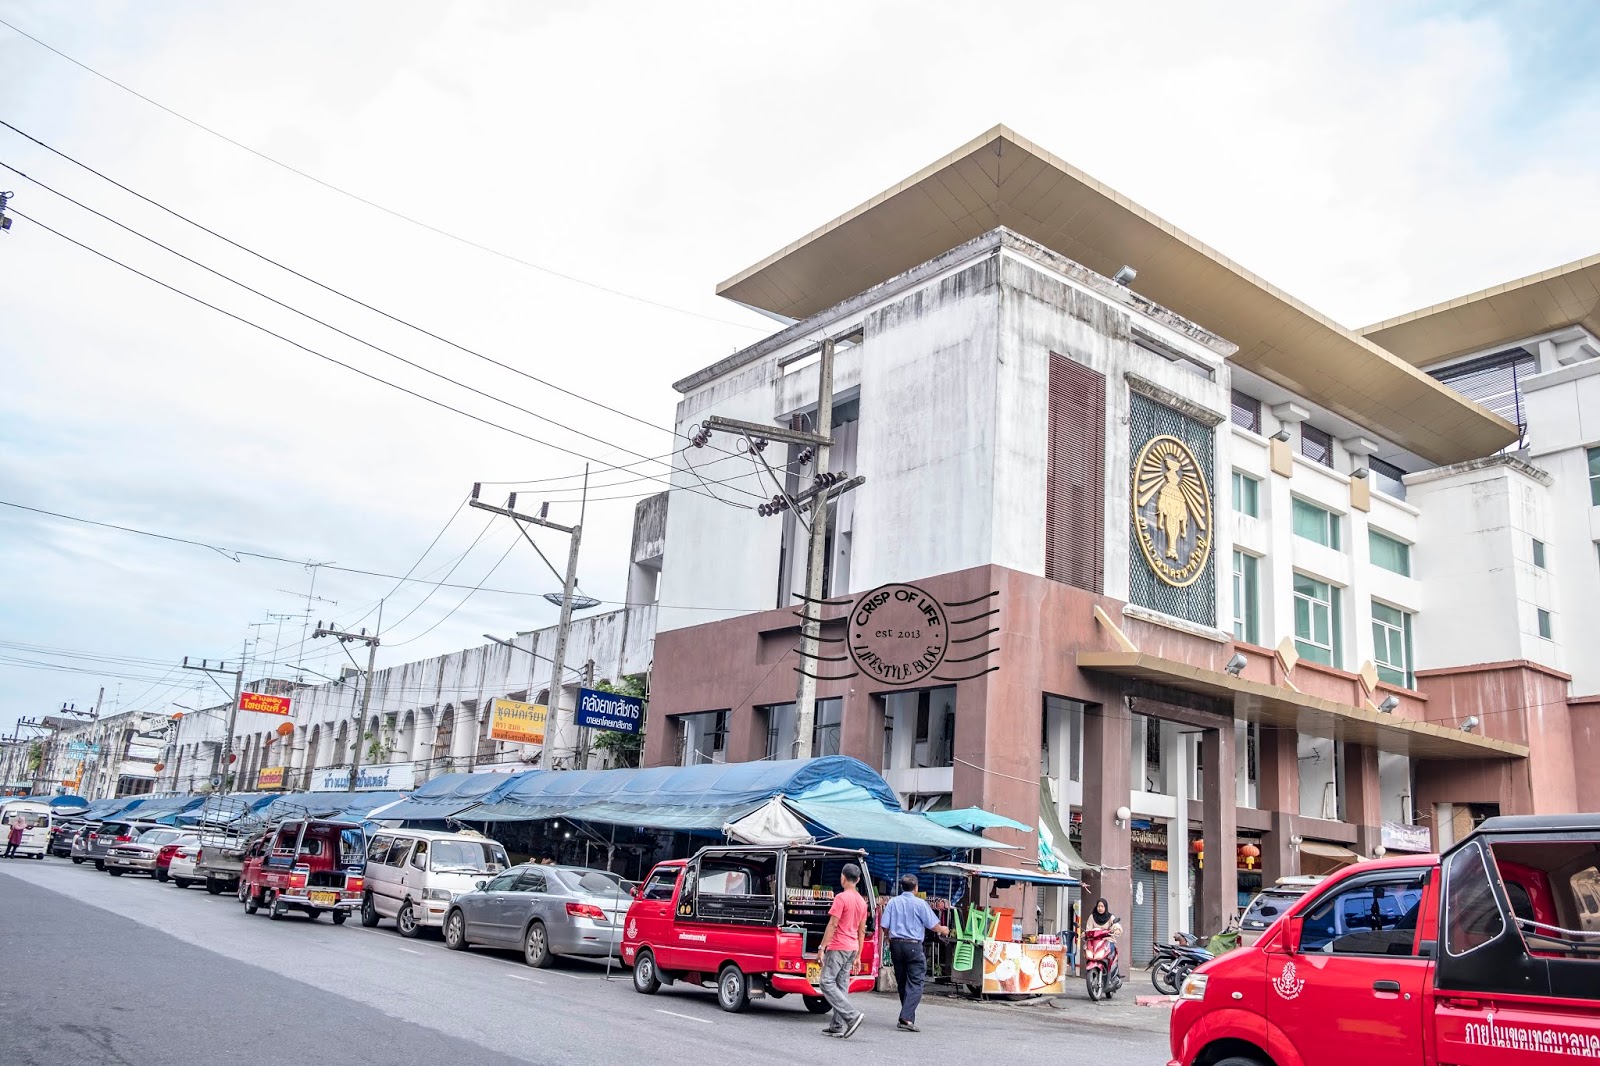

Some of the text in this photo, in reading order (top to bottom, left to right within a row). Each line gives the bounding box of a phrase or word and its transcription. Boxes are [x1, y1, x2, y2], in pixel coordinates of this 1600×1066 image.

[280, 706, 288, 714] 2
[582, 693, 640, 720] คลังยาเภสัชกร
[586, 716, 633, 731] ขายยาโดยเภสัชกร
